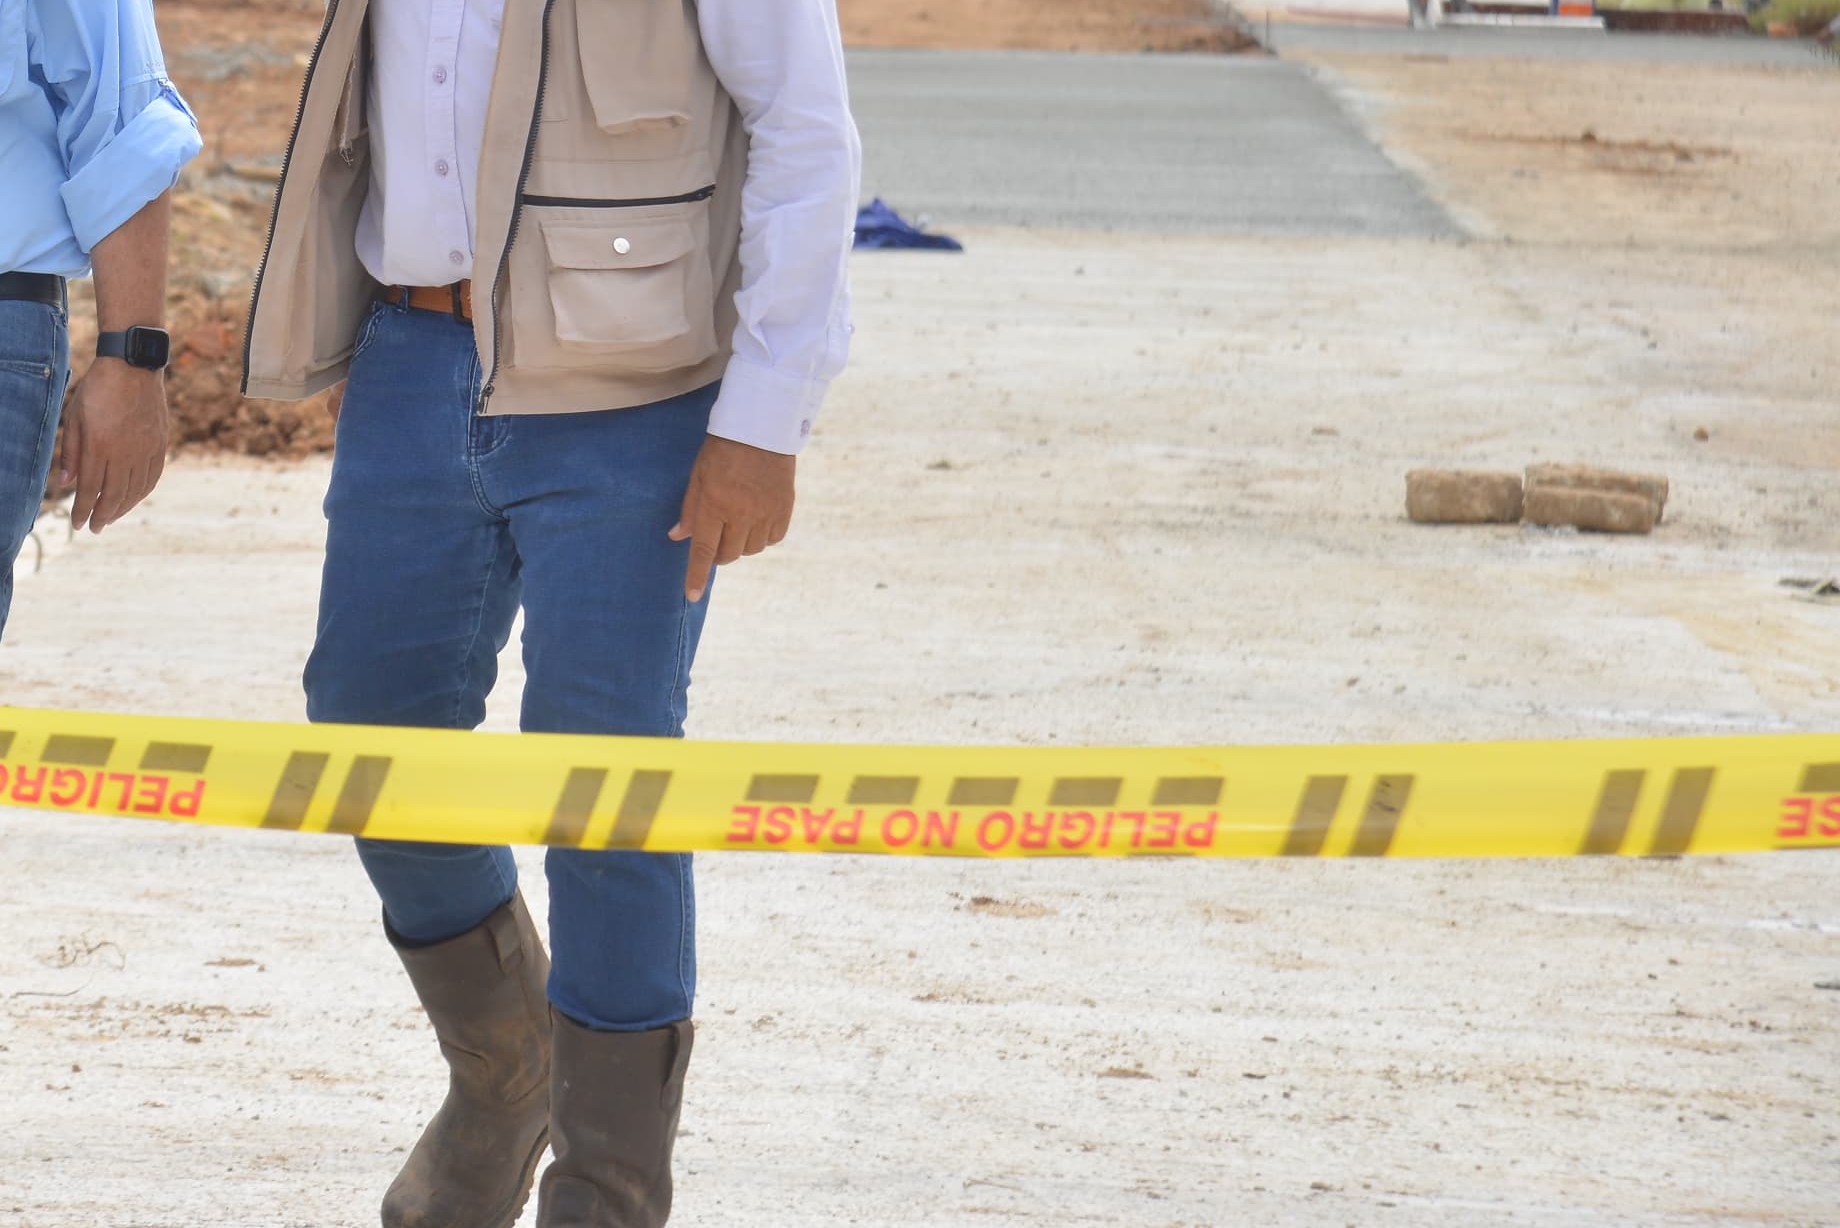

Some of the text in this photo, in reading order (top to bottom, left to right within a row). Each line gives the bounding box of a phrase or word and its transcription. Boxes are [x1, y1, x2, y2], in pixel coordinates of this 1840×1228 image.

[725, 806, 1219, 851] PELIGRO NO PASE
